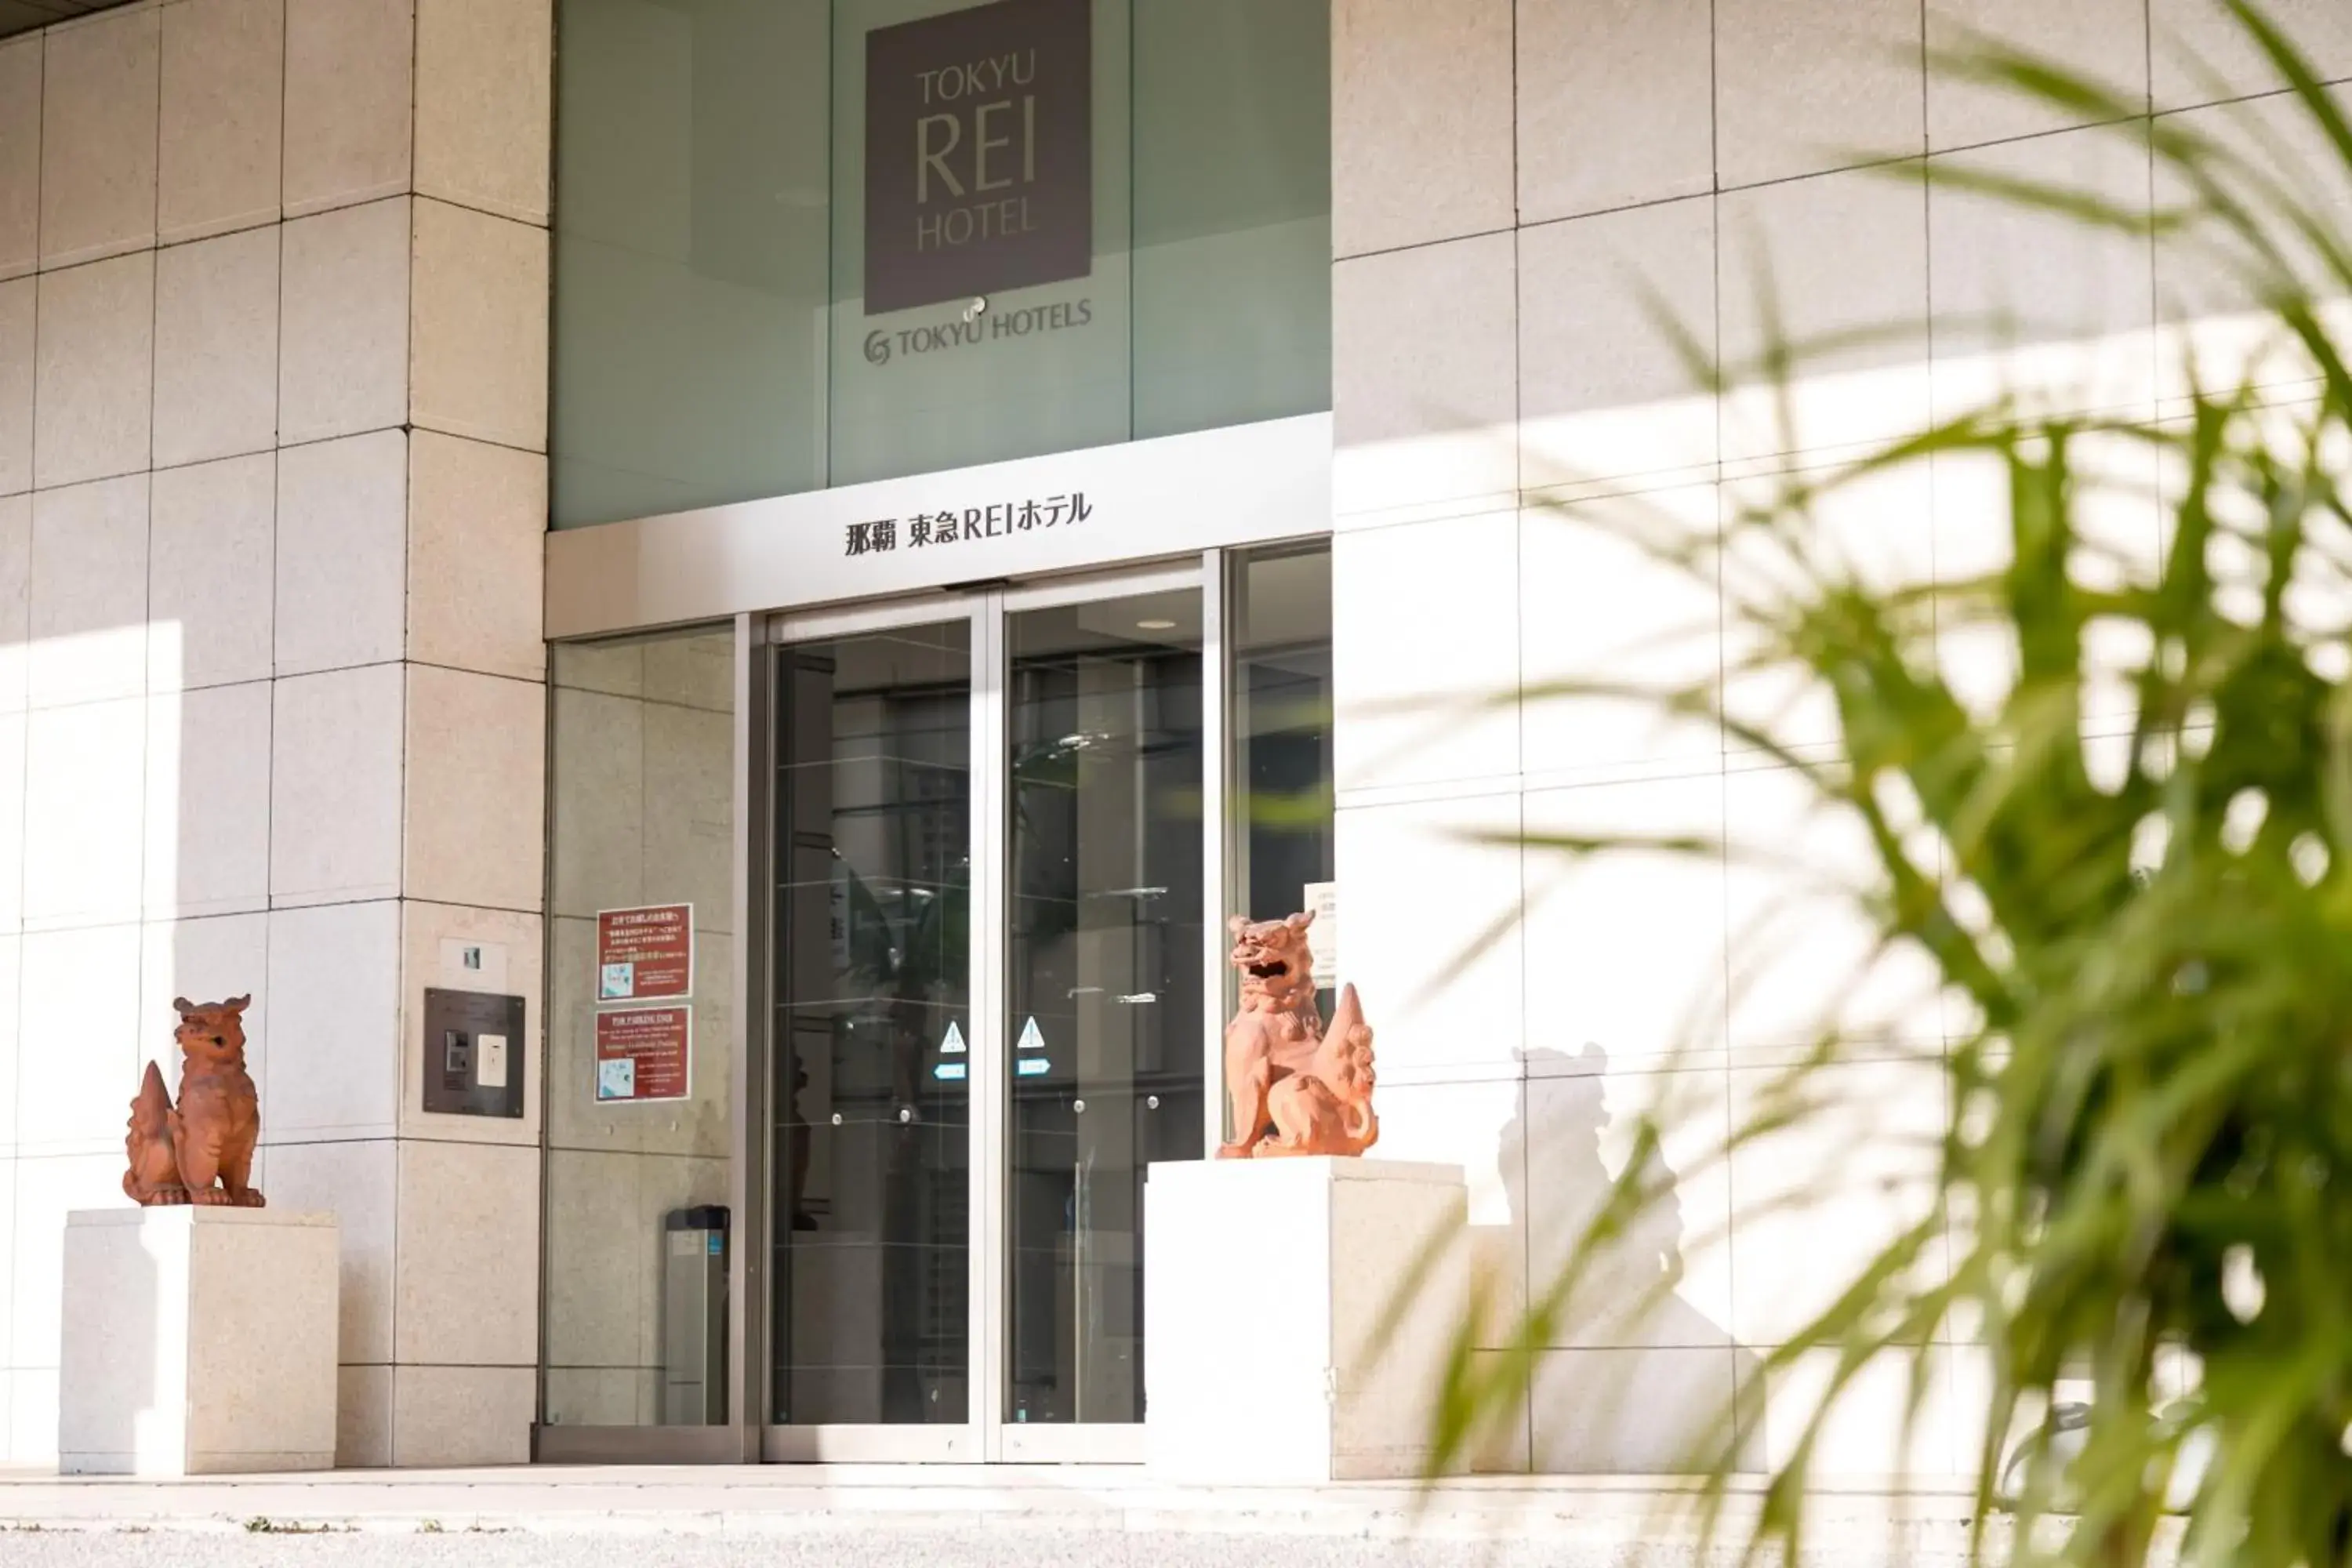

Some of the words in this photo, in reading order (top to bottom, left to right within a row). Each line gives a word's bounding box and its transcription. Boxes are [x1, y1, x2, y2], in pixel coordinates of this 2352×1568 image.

[915, 47, 1036, 104] TOKYU
[916, 95, 1036, 204] REI
[916, 196, 1037, 252] HOTEL
[896, 315, 984, 356] TOKYU
[991, 298, 1093, 340] HOTELS
[844, 517, 898, 557] 那覇
[907, 492, 1093, 548] 東急REIホテル
